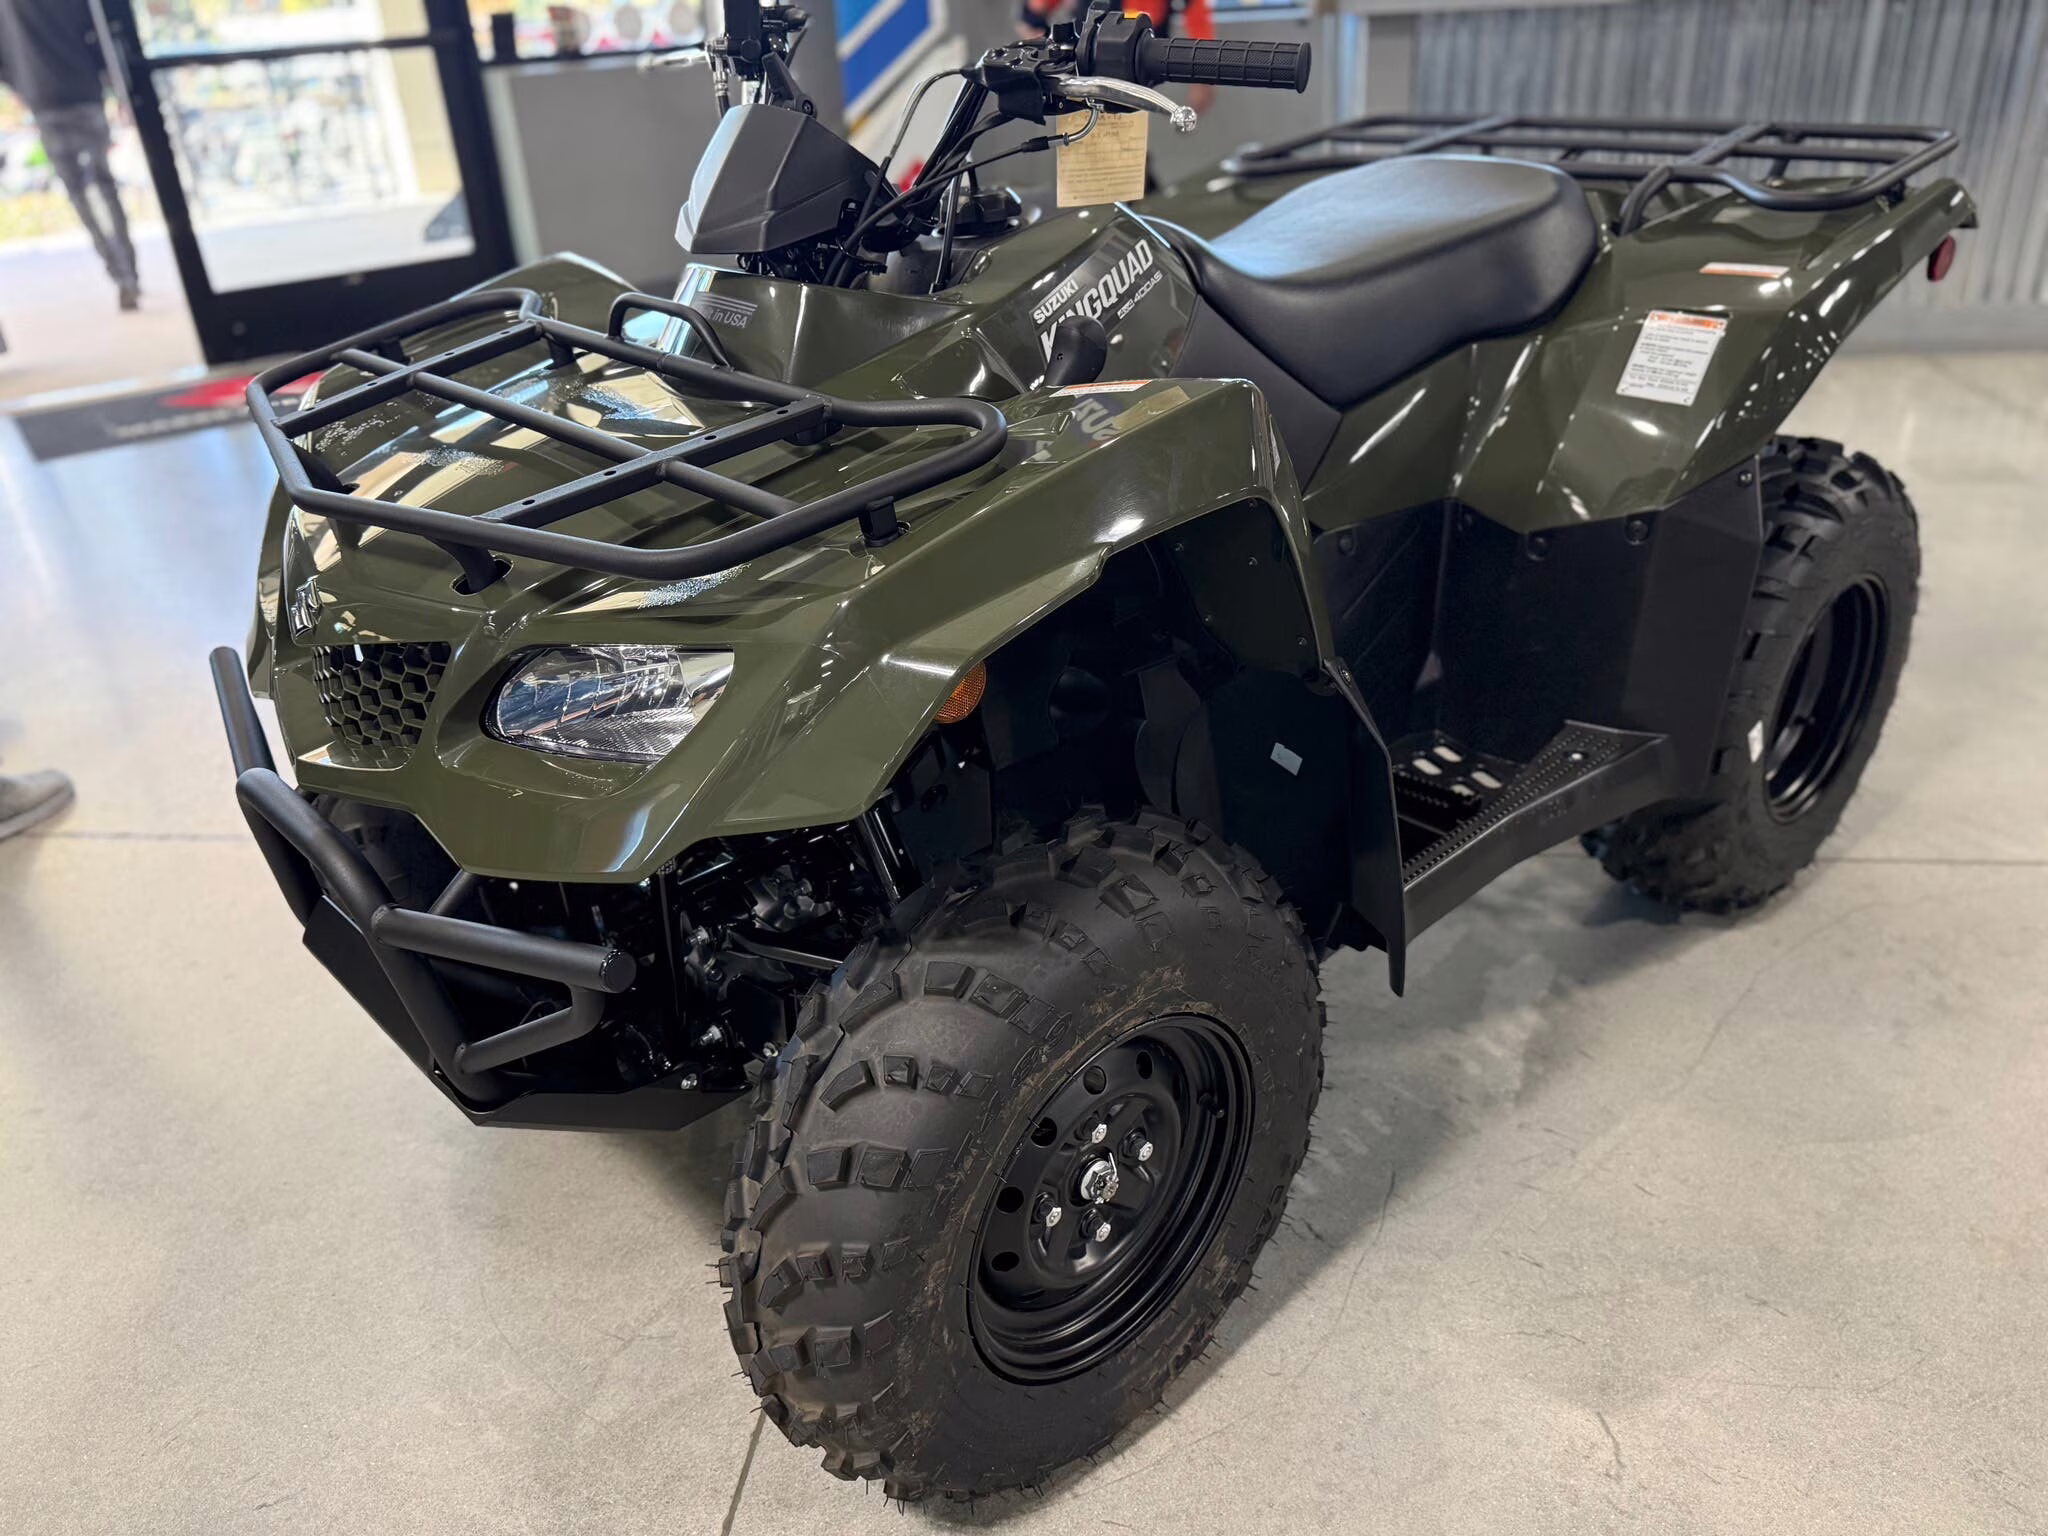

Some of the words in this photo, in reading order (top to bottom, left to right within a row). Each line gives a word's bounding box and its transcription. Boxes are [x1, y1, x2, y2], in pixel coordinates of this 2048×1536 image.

[724, 312, 748, 328] USA
[1033, 278, 1079, 324] SUZUKI
[1041, 239, 1153, 363] KGQUAD
